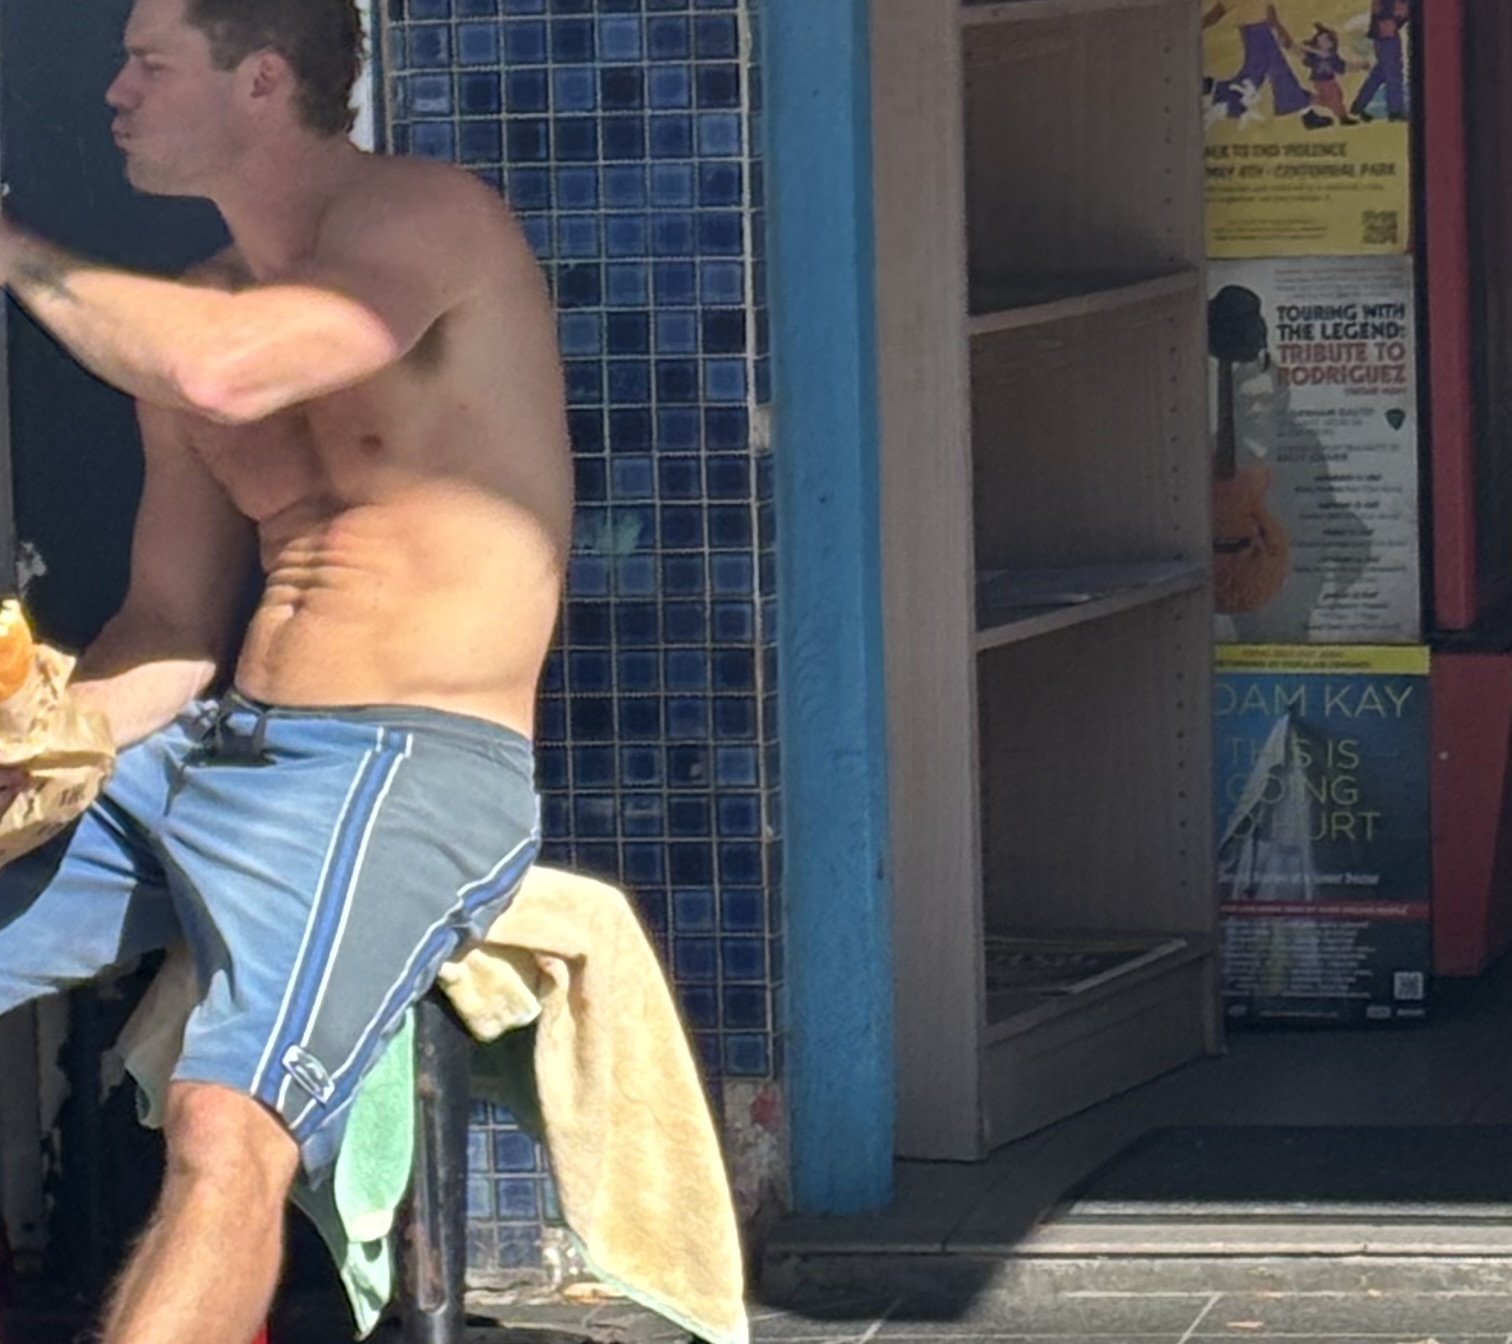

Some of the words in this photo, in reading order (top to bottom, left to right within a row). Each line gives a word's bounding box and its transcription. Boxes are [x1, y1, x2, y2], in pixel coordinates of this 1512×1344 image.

[1277, 305, 1358, 322] TOURING
[1363, 303, 1406, 320] WITH
[1276, 323, 1315, 341] THE
[1321, 322, 1406, 340] LEGEND:
[1277, 342, 1368, 364] TRIBUTE
[1374, 341, 1406, 361] TO
[1277, 364, 1407, 386] RODRIGUEZ
[1324, 683, 1414, 718] KAY
[1326, 738, 1360, 770] IS
[1272, 810, 1382, 843] HURT
